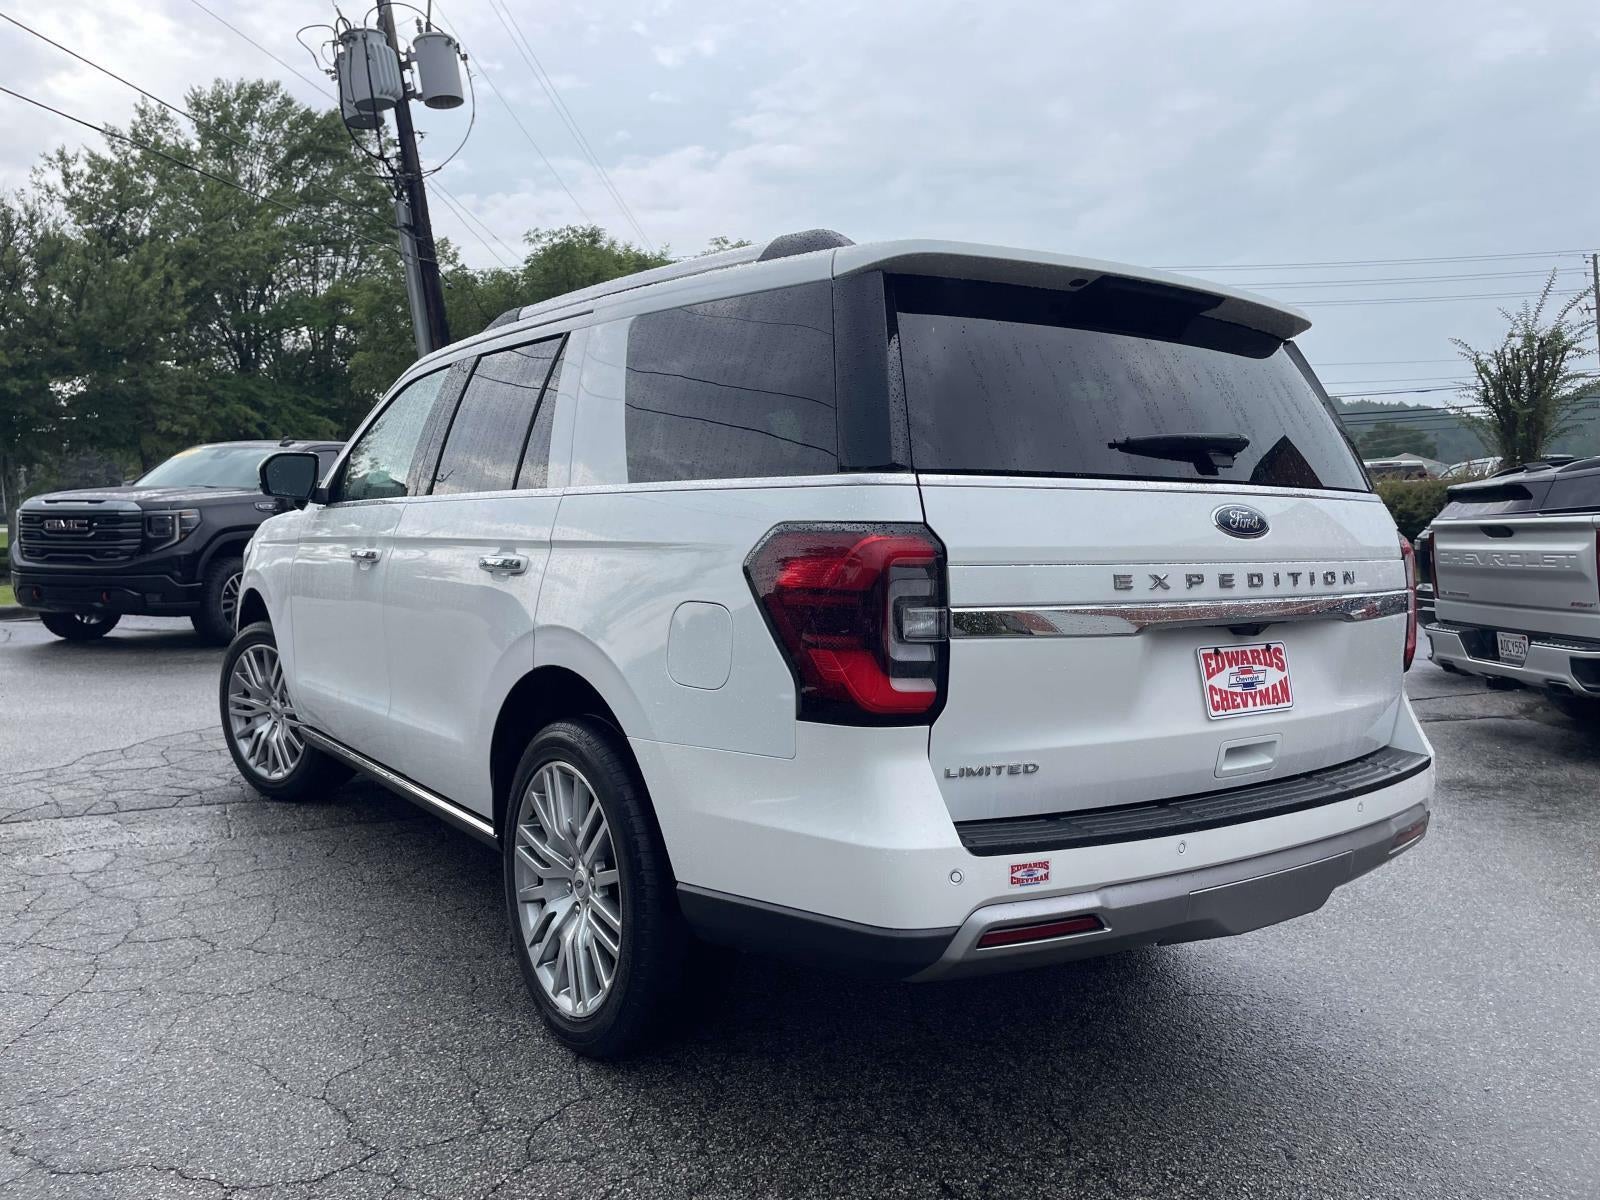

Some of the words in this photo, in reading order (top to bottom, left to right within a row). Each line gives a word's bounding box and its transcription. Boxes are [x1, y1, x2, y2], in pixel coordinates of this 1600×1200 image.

[43, 519, 89, 531] GMC
[1229, 510, 1260, 529] Ford
[1438, 550, 1577, 568] CHEVROLET
[1113, 571, 1355, 590] EXPEDITION
[1202, 647, 1285, 680] EDWARDS
[1235, 674, 1260, 683] Chevrolet
[1208, 675, 1291, 712] CHEVYMAN
[943, 763, 1040, 779] LIMITED
[1010, 860, 1050, 875] EDWARDS
[1010, 871, 1050, 885] CHEVYMAN
